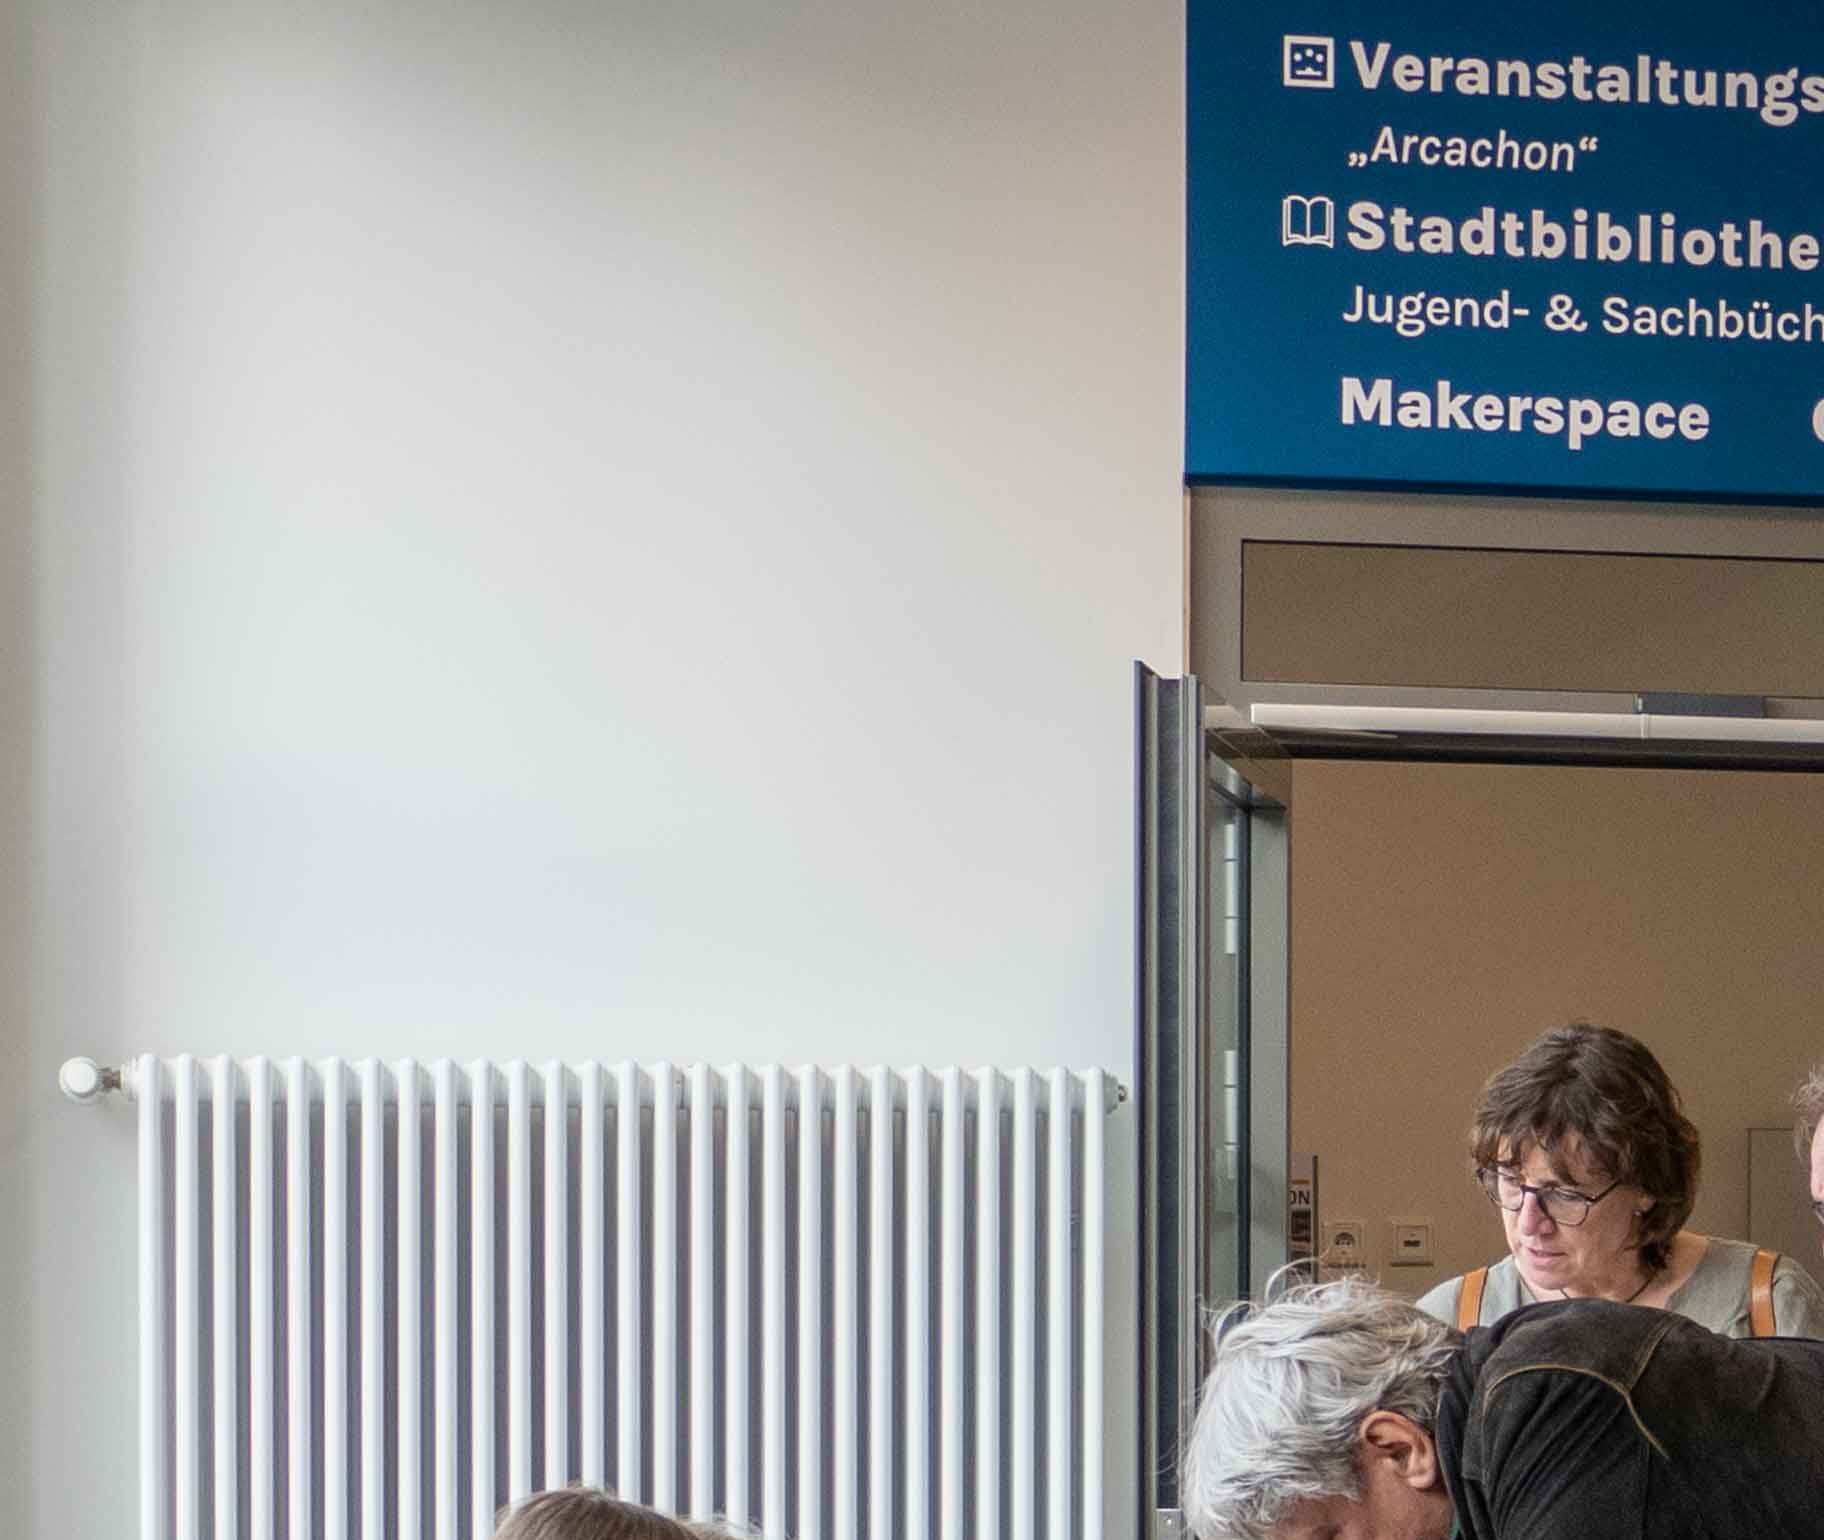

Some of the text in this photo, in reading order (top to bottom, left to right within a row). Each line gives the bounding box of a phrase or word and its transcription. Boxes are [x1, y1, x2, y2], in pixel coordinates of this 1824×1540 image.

[1349, 126, 1597, 171] „Arcachon“
[1343, 286, 1529, 336] Jugend-
[1545, 294, 1587, 331] &
[1342, 377, 1709, 450] Makerspace
